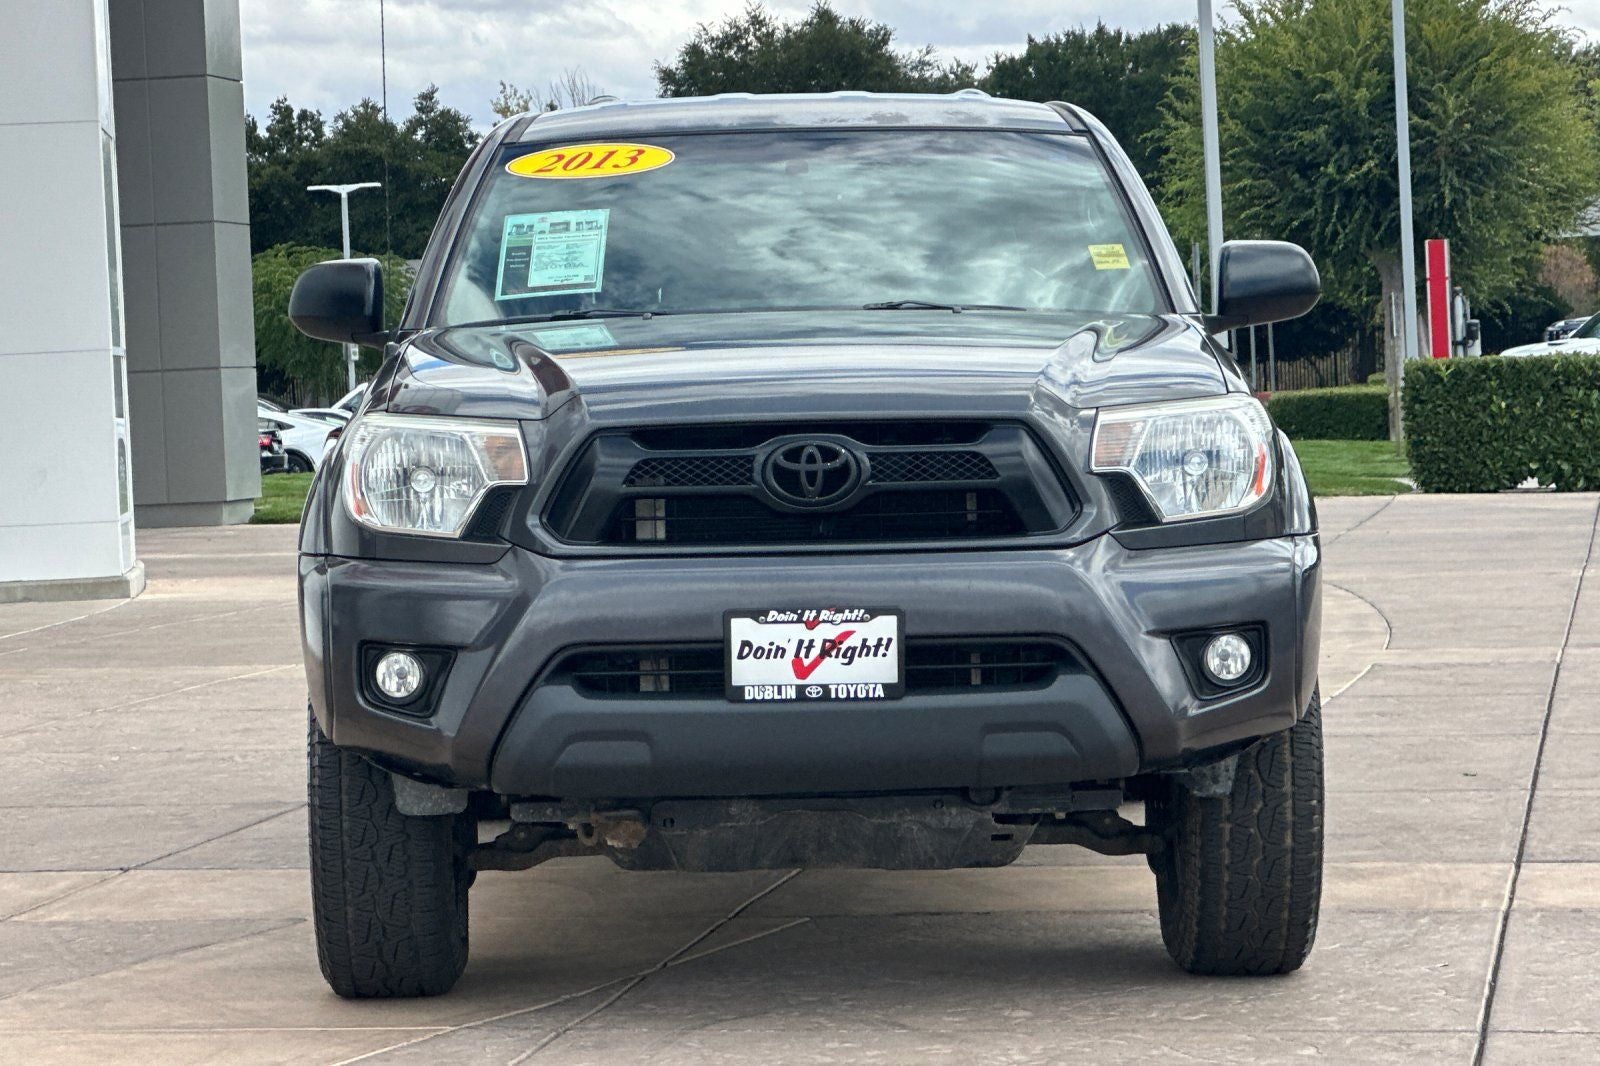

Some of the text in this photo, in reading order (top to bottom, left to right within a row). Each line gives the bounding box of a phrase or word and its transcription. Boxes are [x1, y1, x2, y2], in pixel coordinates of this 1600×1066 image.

[532, 149, 646, 174] 2013
[766, 609, 865, 625] Doin' It Right!
[737, 637, 894, 666] Doin' It Right!
[744, 683, 885, 700] DUBLIN TOYOTA
